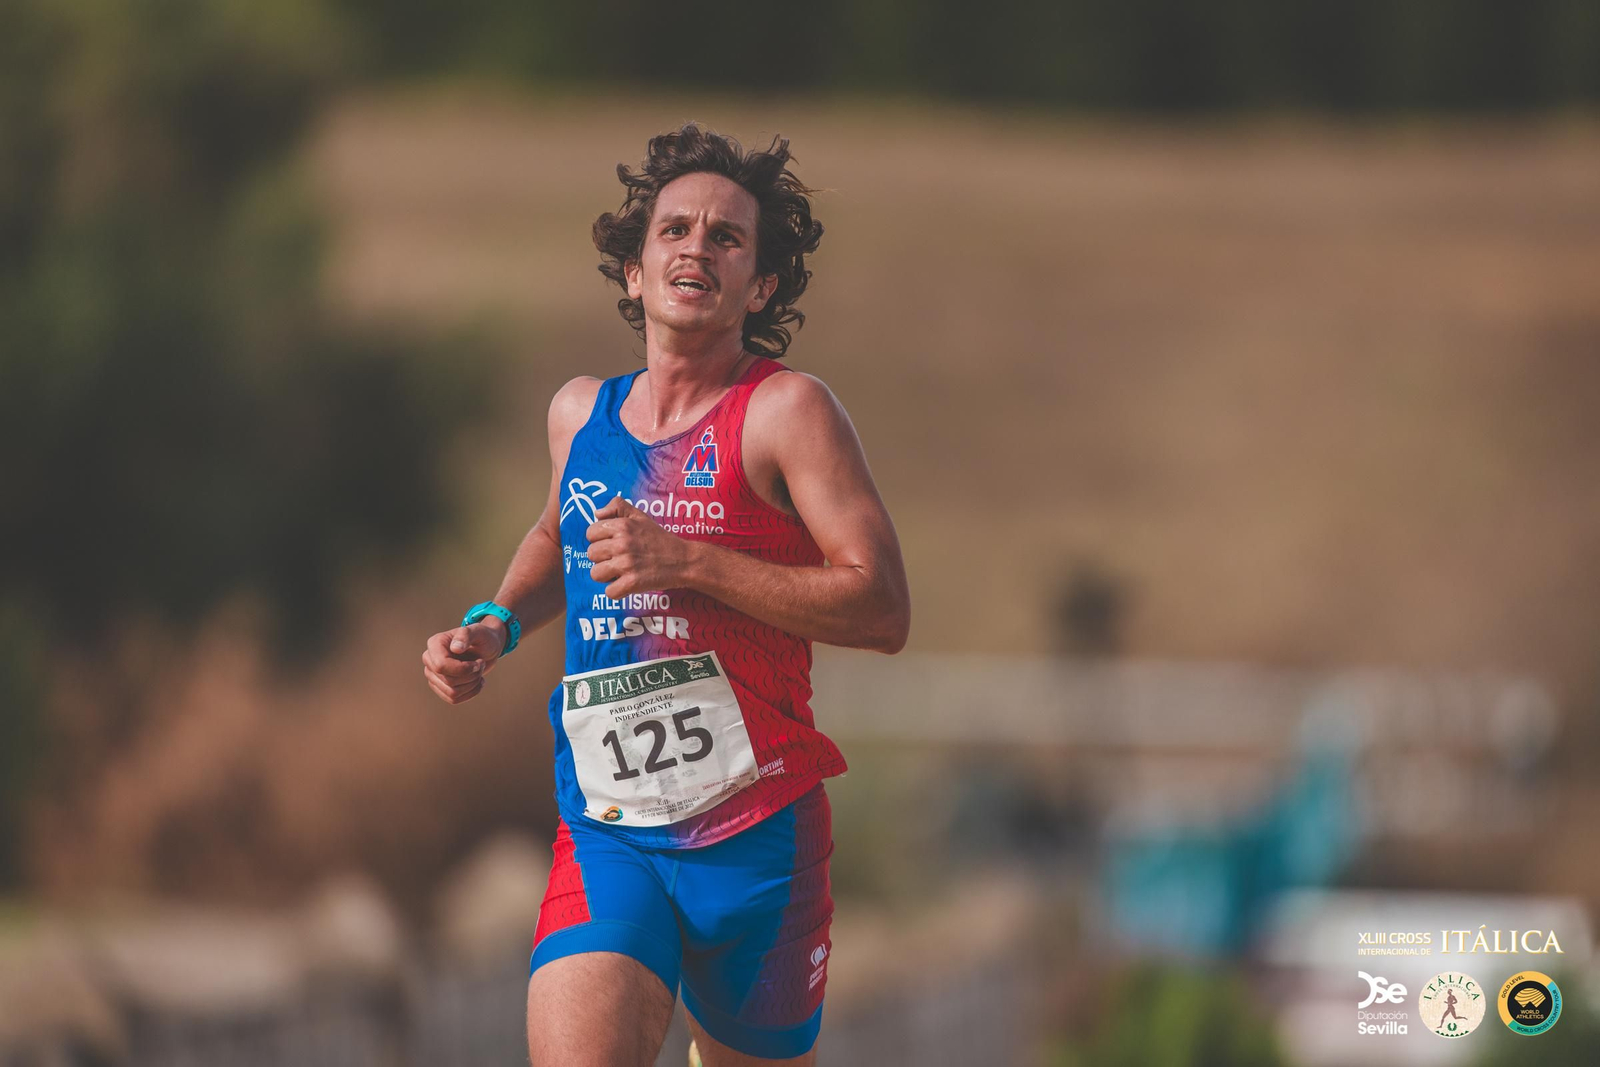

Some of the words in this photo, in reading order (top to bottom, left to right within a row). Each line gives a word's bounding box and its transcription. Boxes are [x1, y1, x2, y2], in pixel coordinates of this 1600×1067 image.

[685, 477, 714, 487] DELSUR
[592, 594, 670, 610] ATLETISMO
[579, 616, 690, 641] DELSUR
[599, 667, 676, 698] ITÁLICA
[609, 704, 633, 715] PABLO
[633, 693, 675, 709] GONZÁLEZ
[615, 701, 674, 722] INDEPENDIENTE
[602, 706, 713, 781] 125
